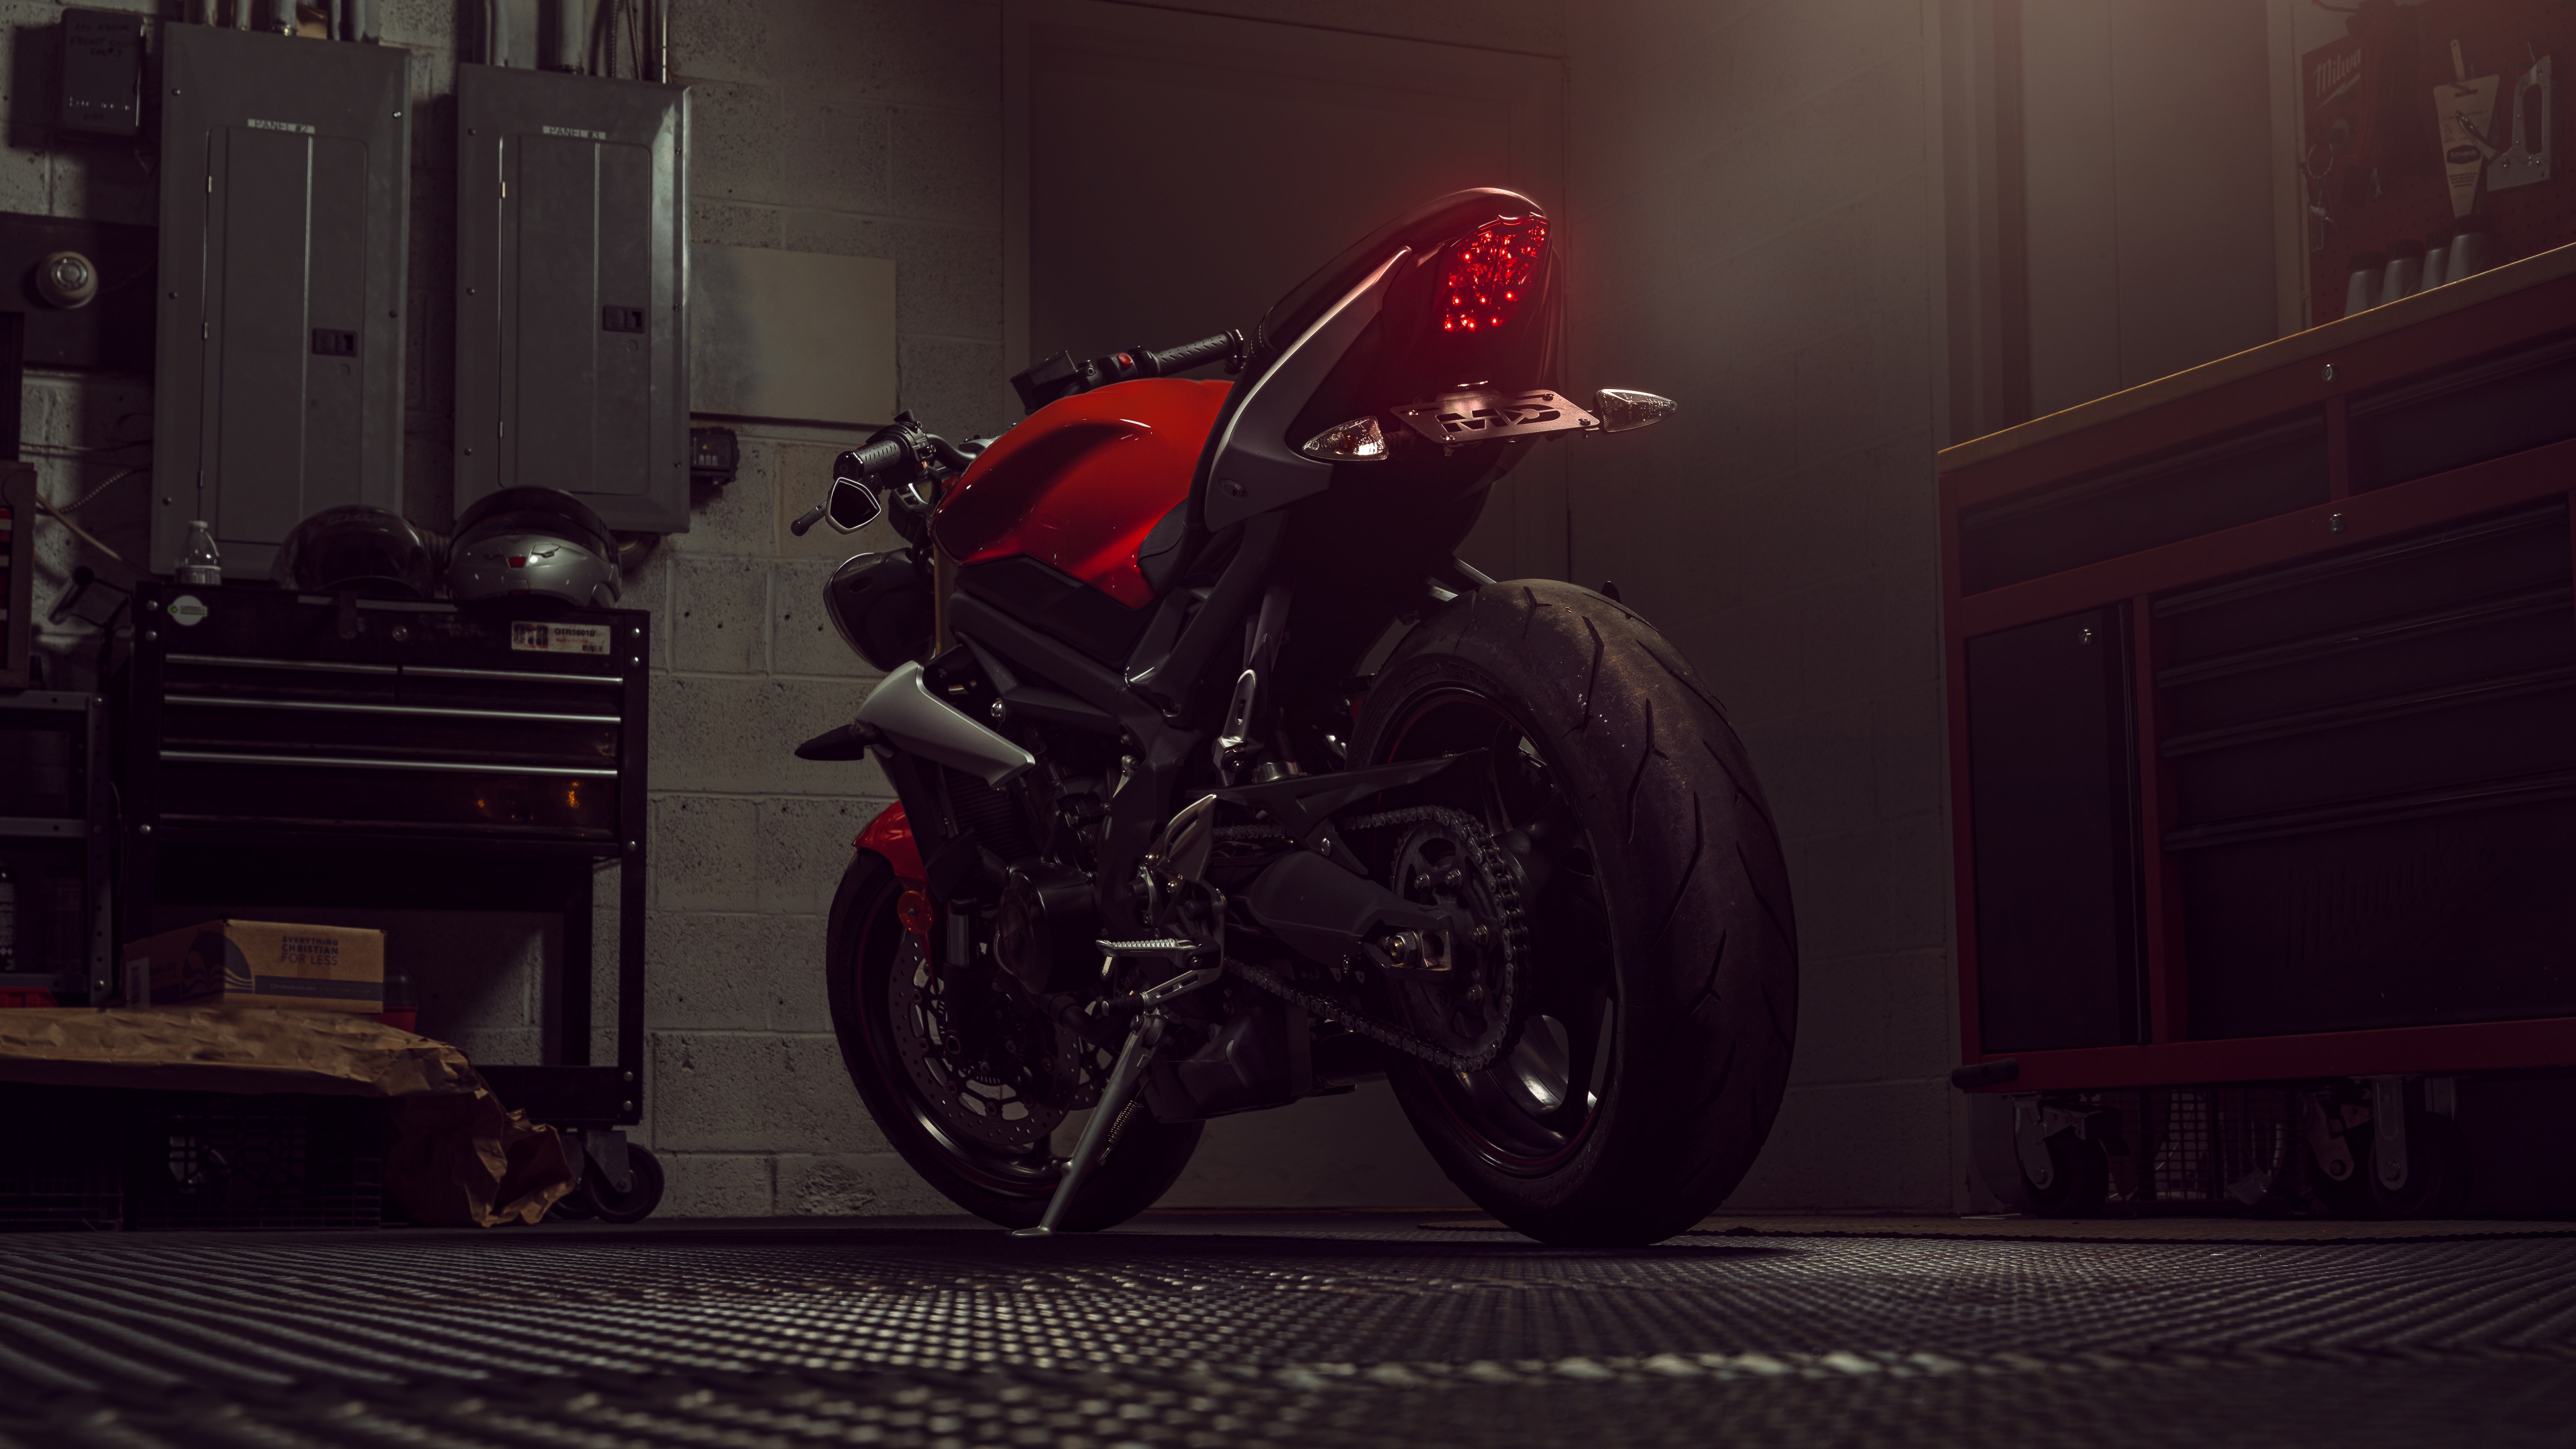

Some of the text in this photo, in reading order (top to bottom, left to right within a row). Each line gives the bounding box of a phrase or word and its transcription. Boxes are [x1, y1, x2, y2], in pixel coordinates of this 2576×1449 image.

[2312, 48, 2361, 98] Milwa
[255, 119, 290, 132] PANEL
[550, 125, 583, 138] PANEL
[2450, 149, 2477, 159] Edwards
[282, 936, 339, 946] EVERYTHING
[281, 944, 339, 955] CHRISTIAN
[281, 953, 338, 966] FOR LESS
